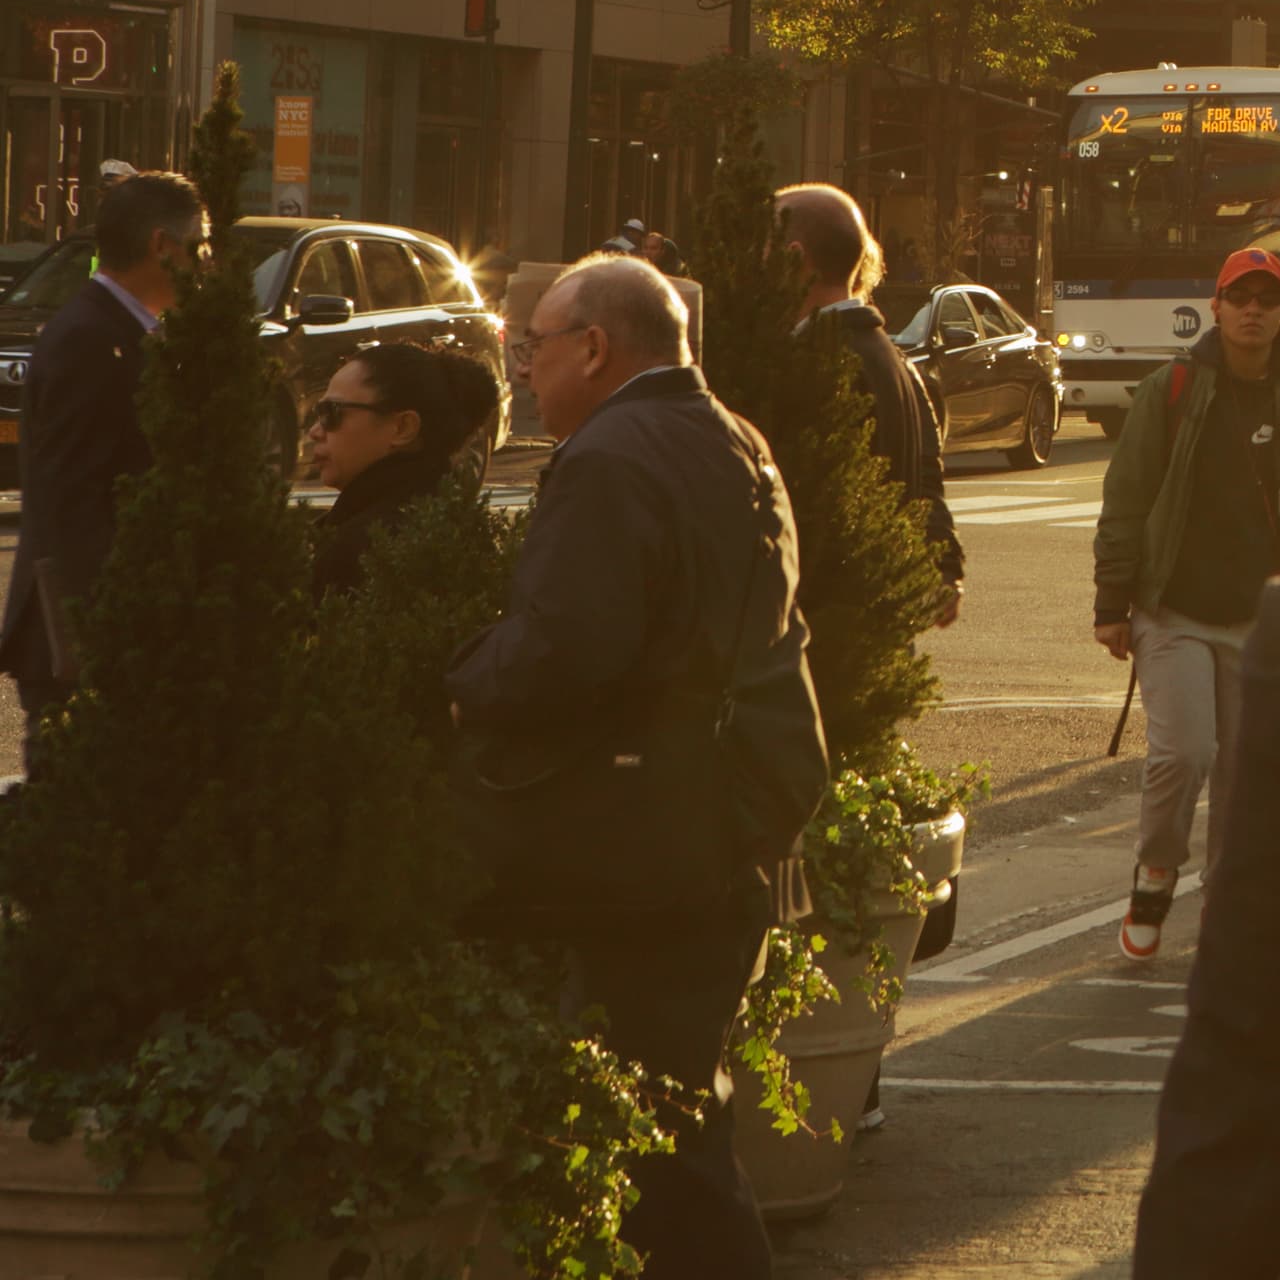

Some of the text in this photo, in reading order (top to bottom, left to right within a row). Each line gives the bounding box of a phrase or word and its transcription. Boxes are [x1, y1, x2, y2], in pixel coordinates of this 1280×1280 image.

[279, 110, 309, 121] NYC
[1101, 107, 1128, 133] x2
[1162, 112, 1183, 121] VIA
[1235, 107, 1272, 120] DRIVE
[1161, 120, 1278, 133] VIA MADISON AV
[1079, 142, 1099, 157] 058
[1173, 313, 1196, 333] MTA
